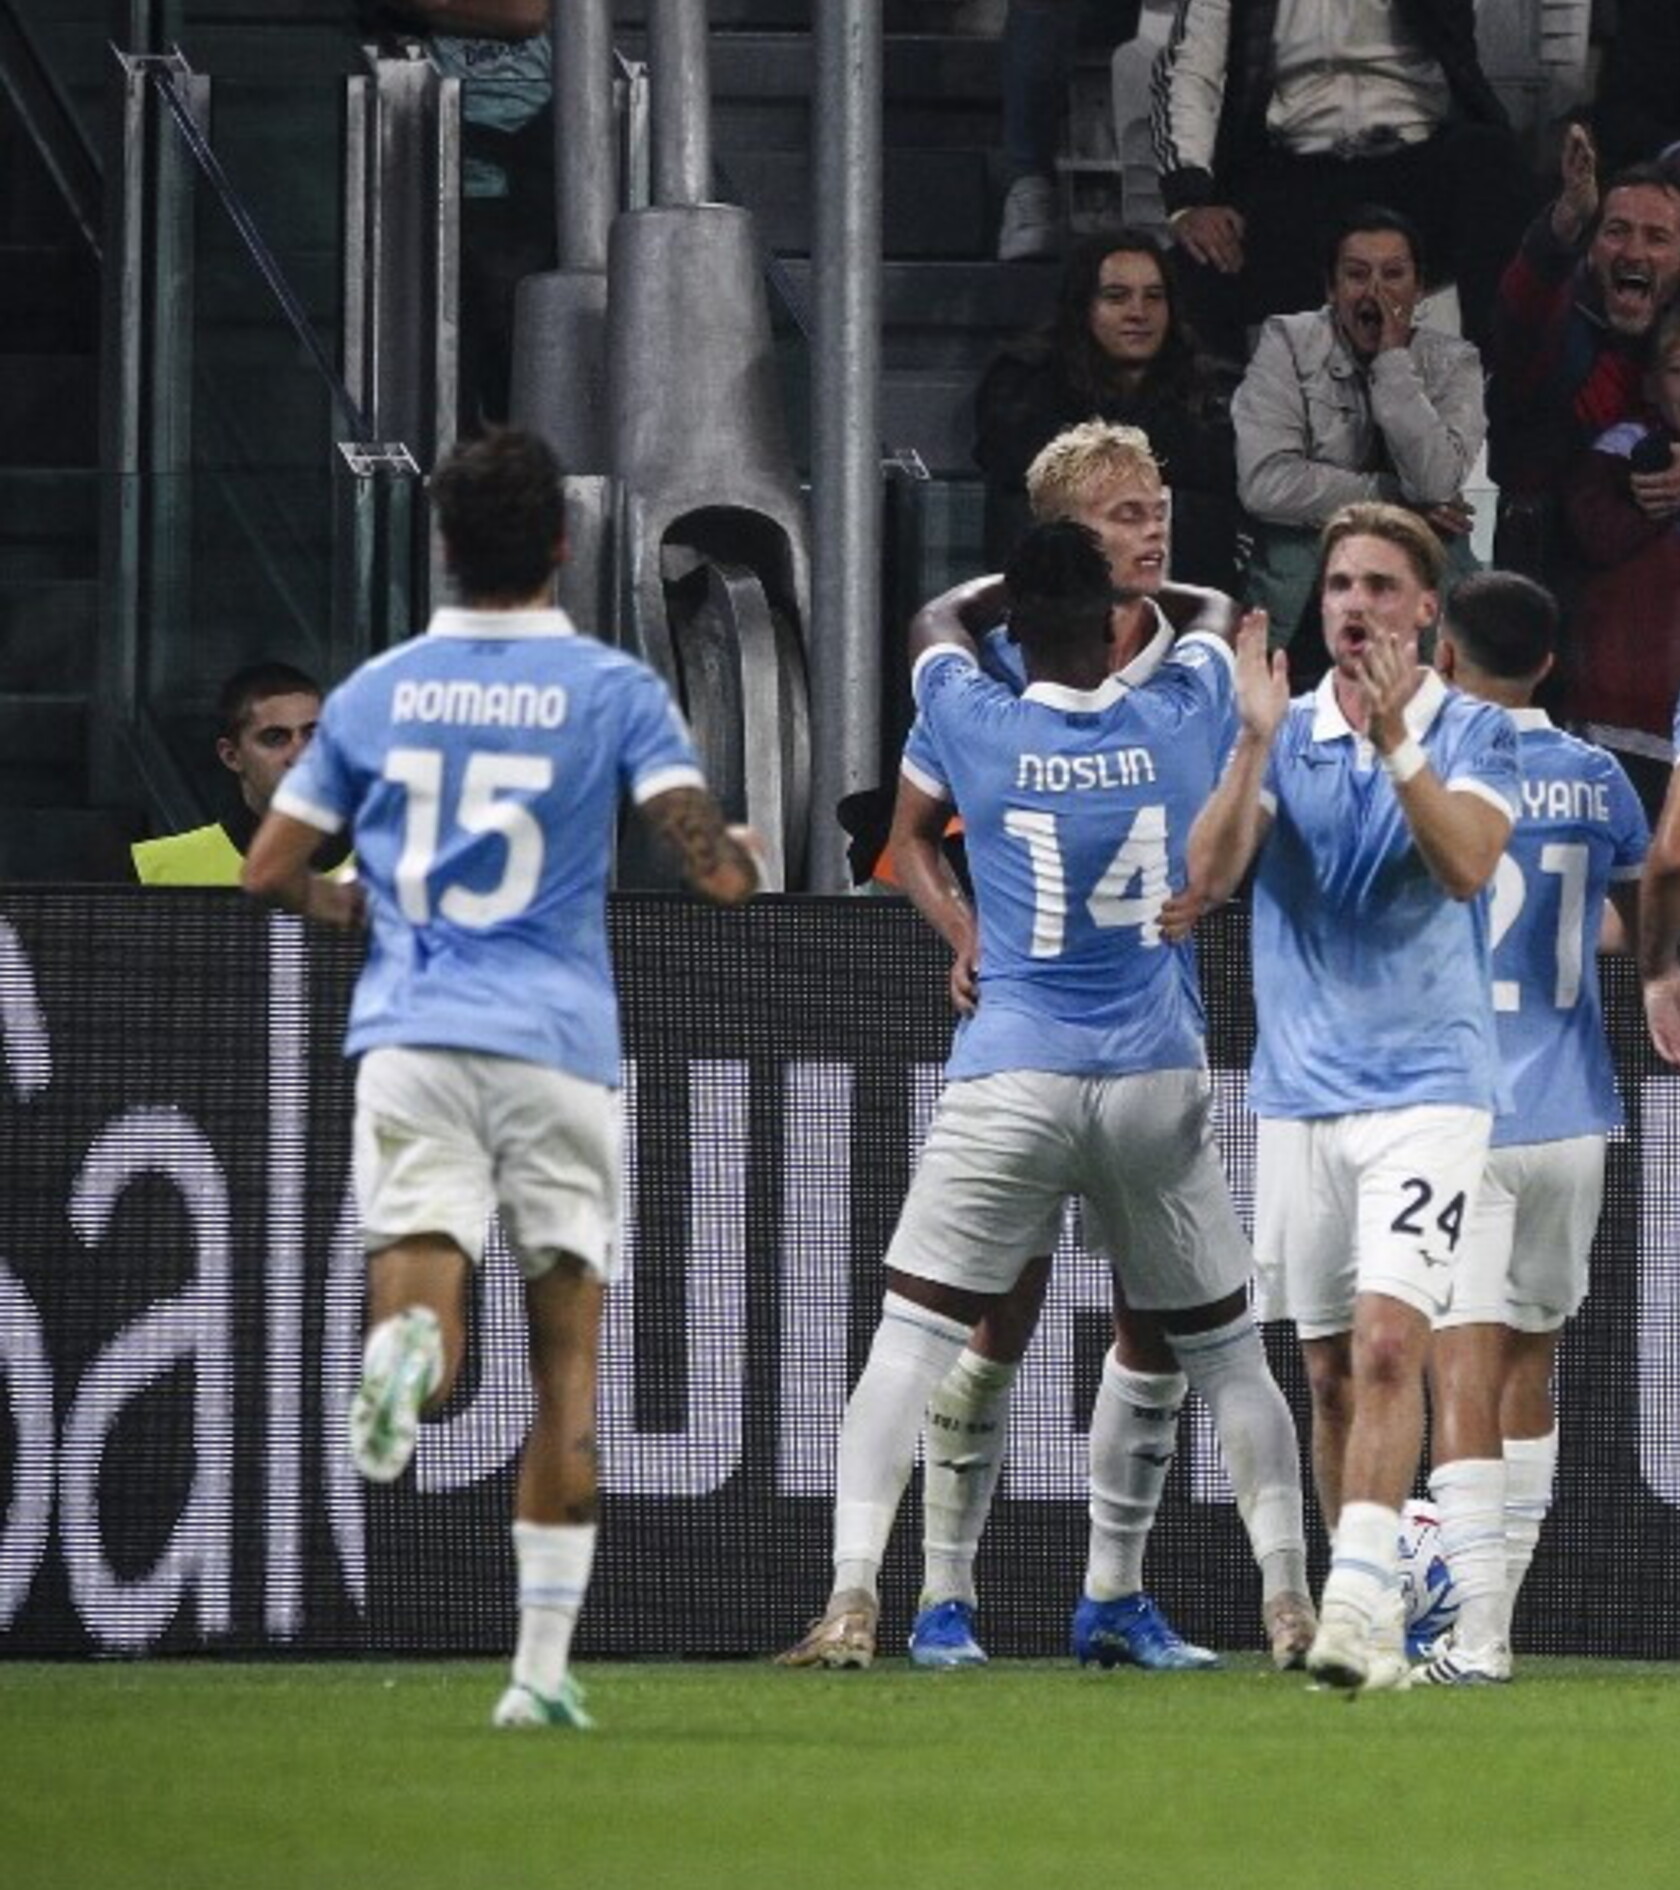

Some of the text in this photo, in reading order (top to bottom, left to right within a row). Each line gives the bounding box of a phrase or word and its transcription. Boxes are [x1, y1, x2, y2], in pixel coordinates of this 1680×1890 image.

[391, 681, 567, 728] ROMANO
[1016, 748, 1156, 792] NOSLIN
[1514, 781, 1610, 822] YANE
[384, 748, 554, 929] 15
[1003, 805, 1173, 960] 14
[1391, 1177, 1466, 1254] 24
